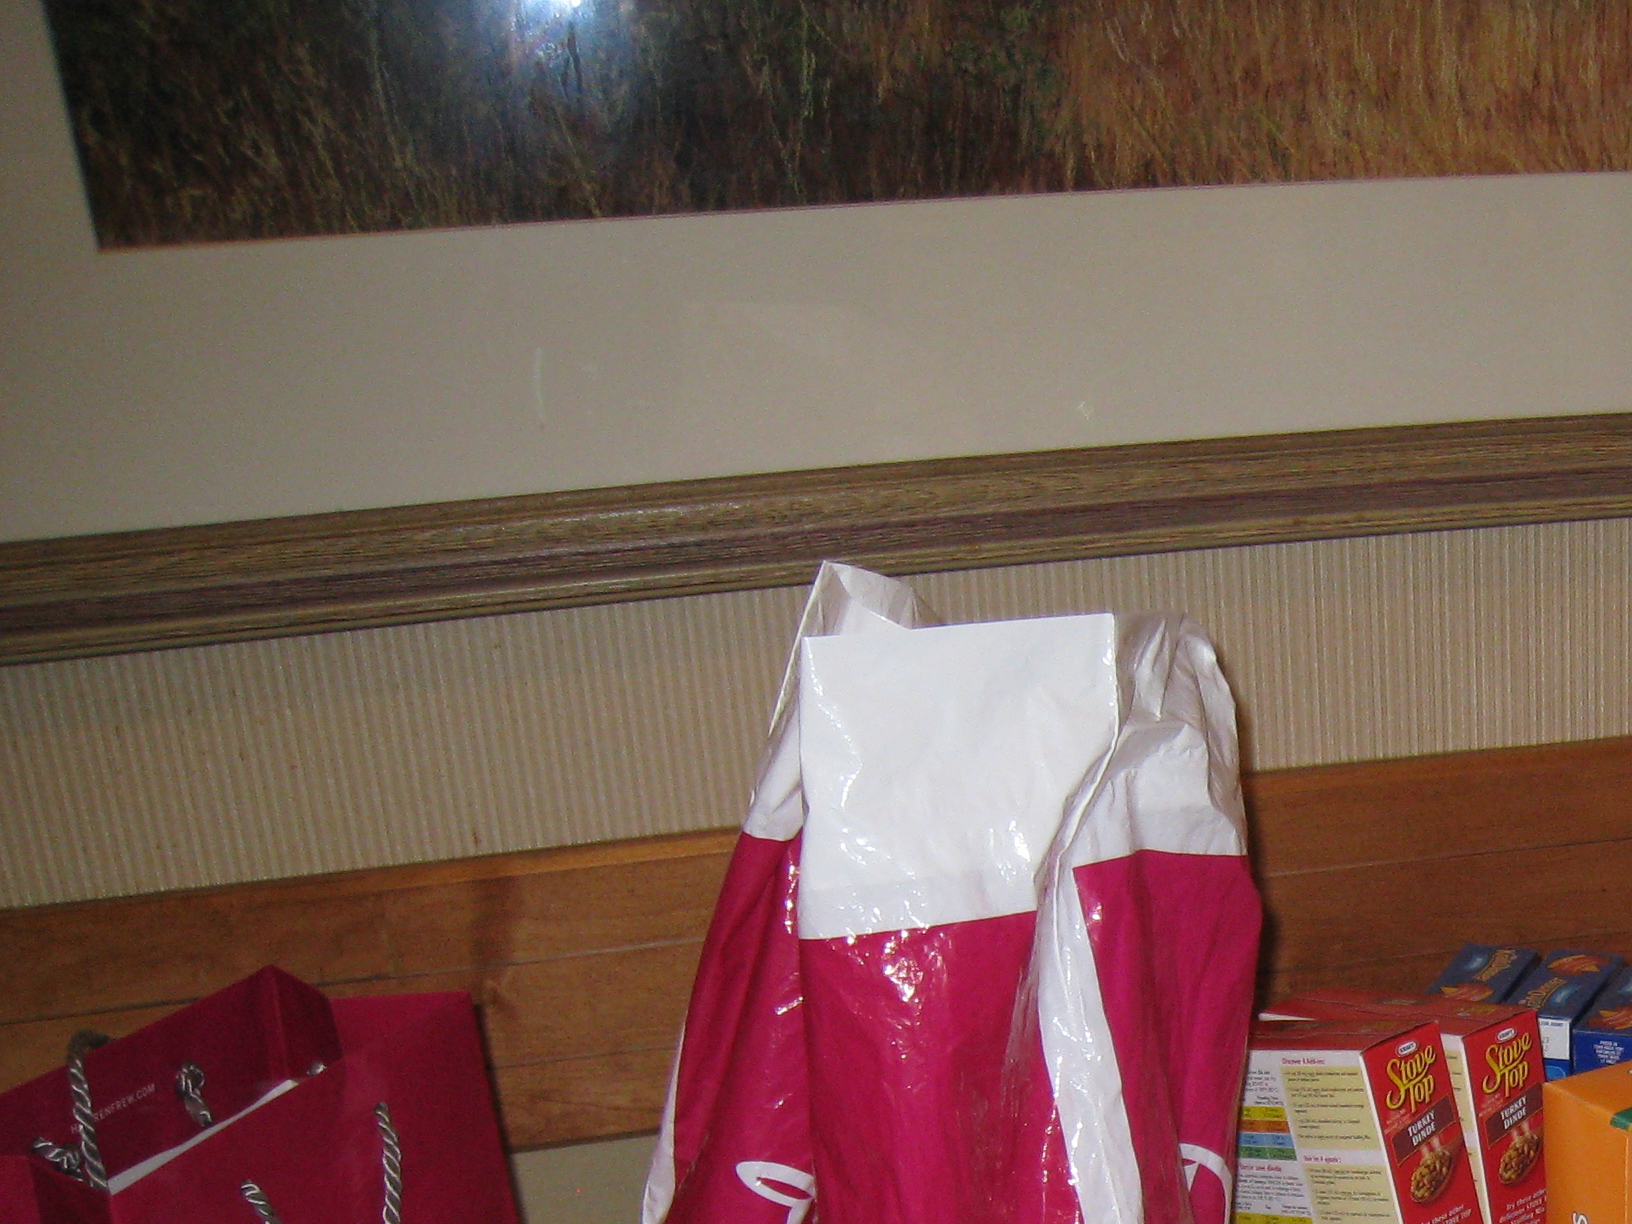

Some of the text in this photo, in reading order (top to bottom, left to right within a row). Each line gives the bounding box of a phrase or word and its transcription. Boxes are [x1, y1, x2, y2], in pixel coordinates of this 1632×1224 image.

[1386, 1045, 1436, 1110] Stove
[1483, 1032, 1532, 1093] Stove
[1499, 1060, 1528, 1097] Top
[70, 1083, 156, 1135] HRENFREW.COM
[1408, 1074, 1435, 1113] Top
[1500, 1095, 1527, 1121] TURKEY
[1407, 1110, 1436, 1137] TURKEY
[1411, 1121, 1437, 1147] DINDE
[1504, 1107, 1527, 1130] DINDE
